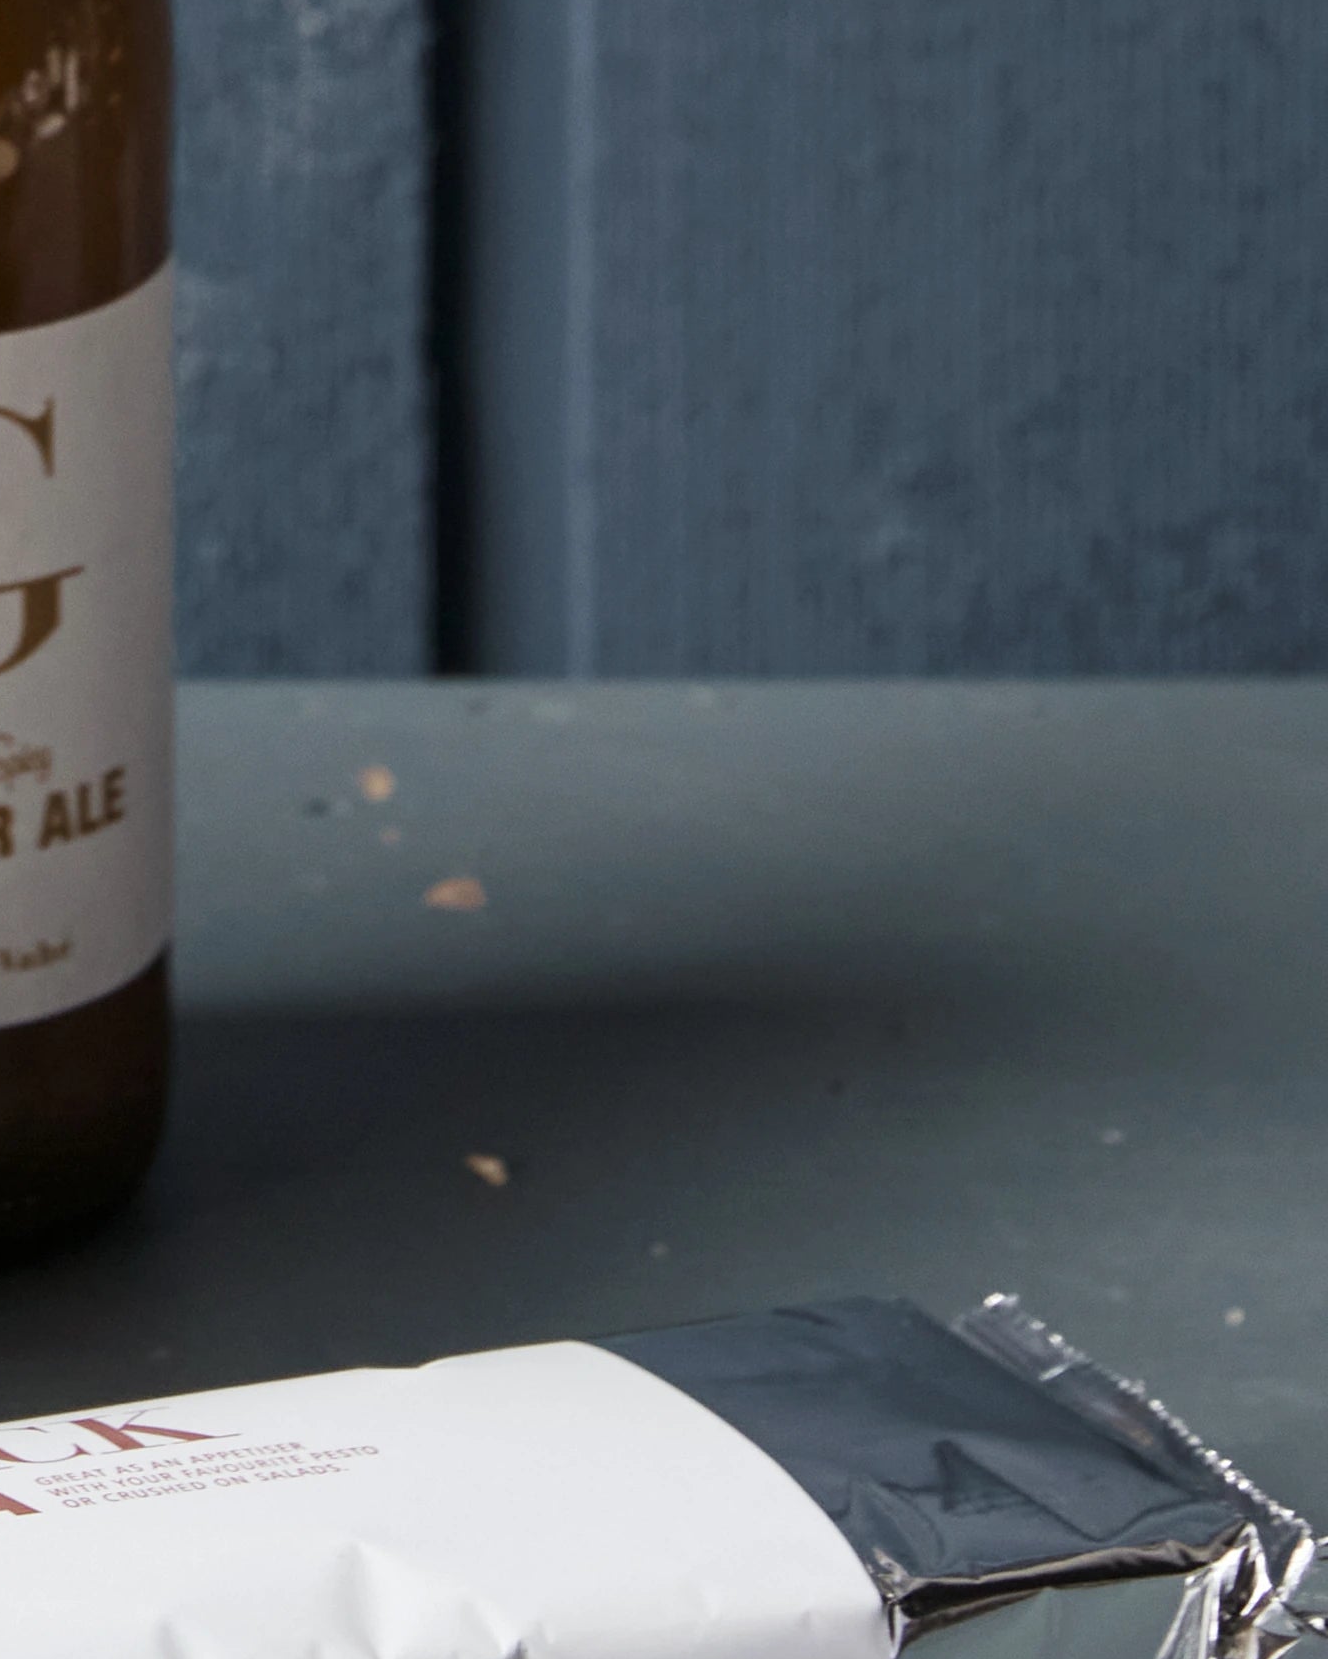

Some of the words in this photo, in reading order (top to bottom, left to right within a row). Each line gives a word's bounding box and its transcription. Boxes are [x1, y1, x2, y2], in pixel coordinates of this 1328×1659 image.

[37, 764, 127, 850] ALE
[34, 1468, 107, 1486] GREAT
[116, 1463, 144, 1475] AS
[151, 1457, 183, 1470] AN
[189, 1441, 306, 1466] APPETISER
[47, 1480, 109, 1497] WITH
[111, 1471, 178, 1487] YOUR
[181, 1454, 305, 1479] FAVOURITE
[309, 1445, 380, 1462] PESTO
[61, 1495, 97, 1509] OR
[102, 1479, 208, 1503] CRUSHED
[213, 1474, 250, 1488] ON
[254, 1463, 351, 1482] SALADS.
